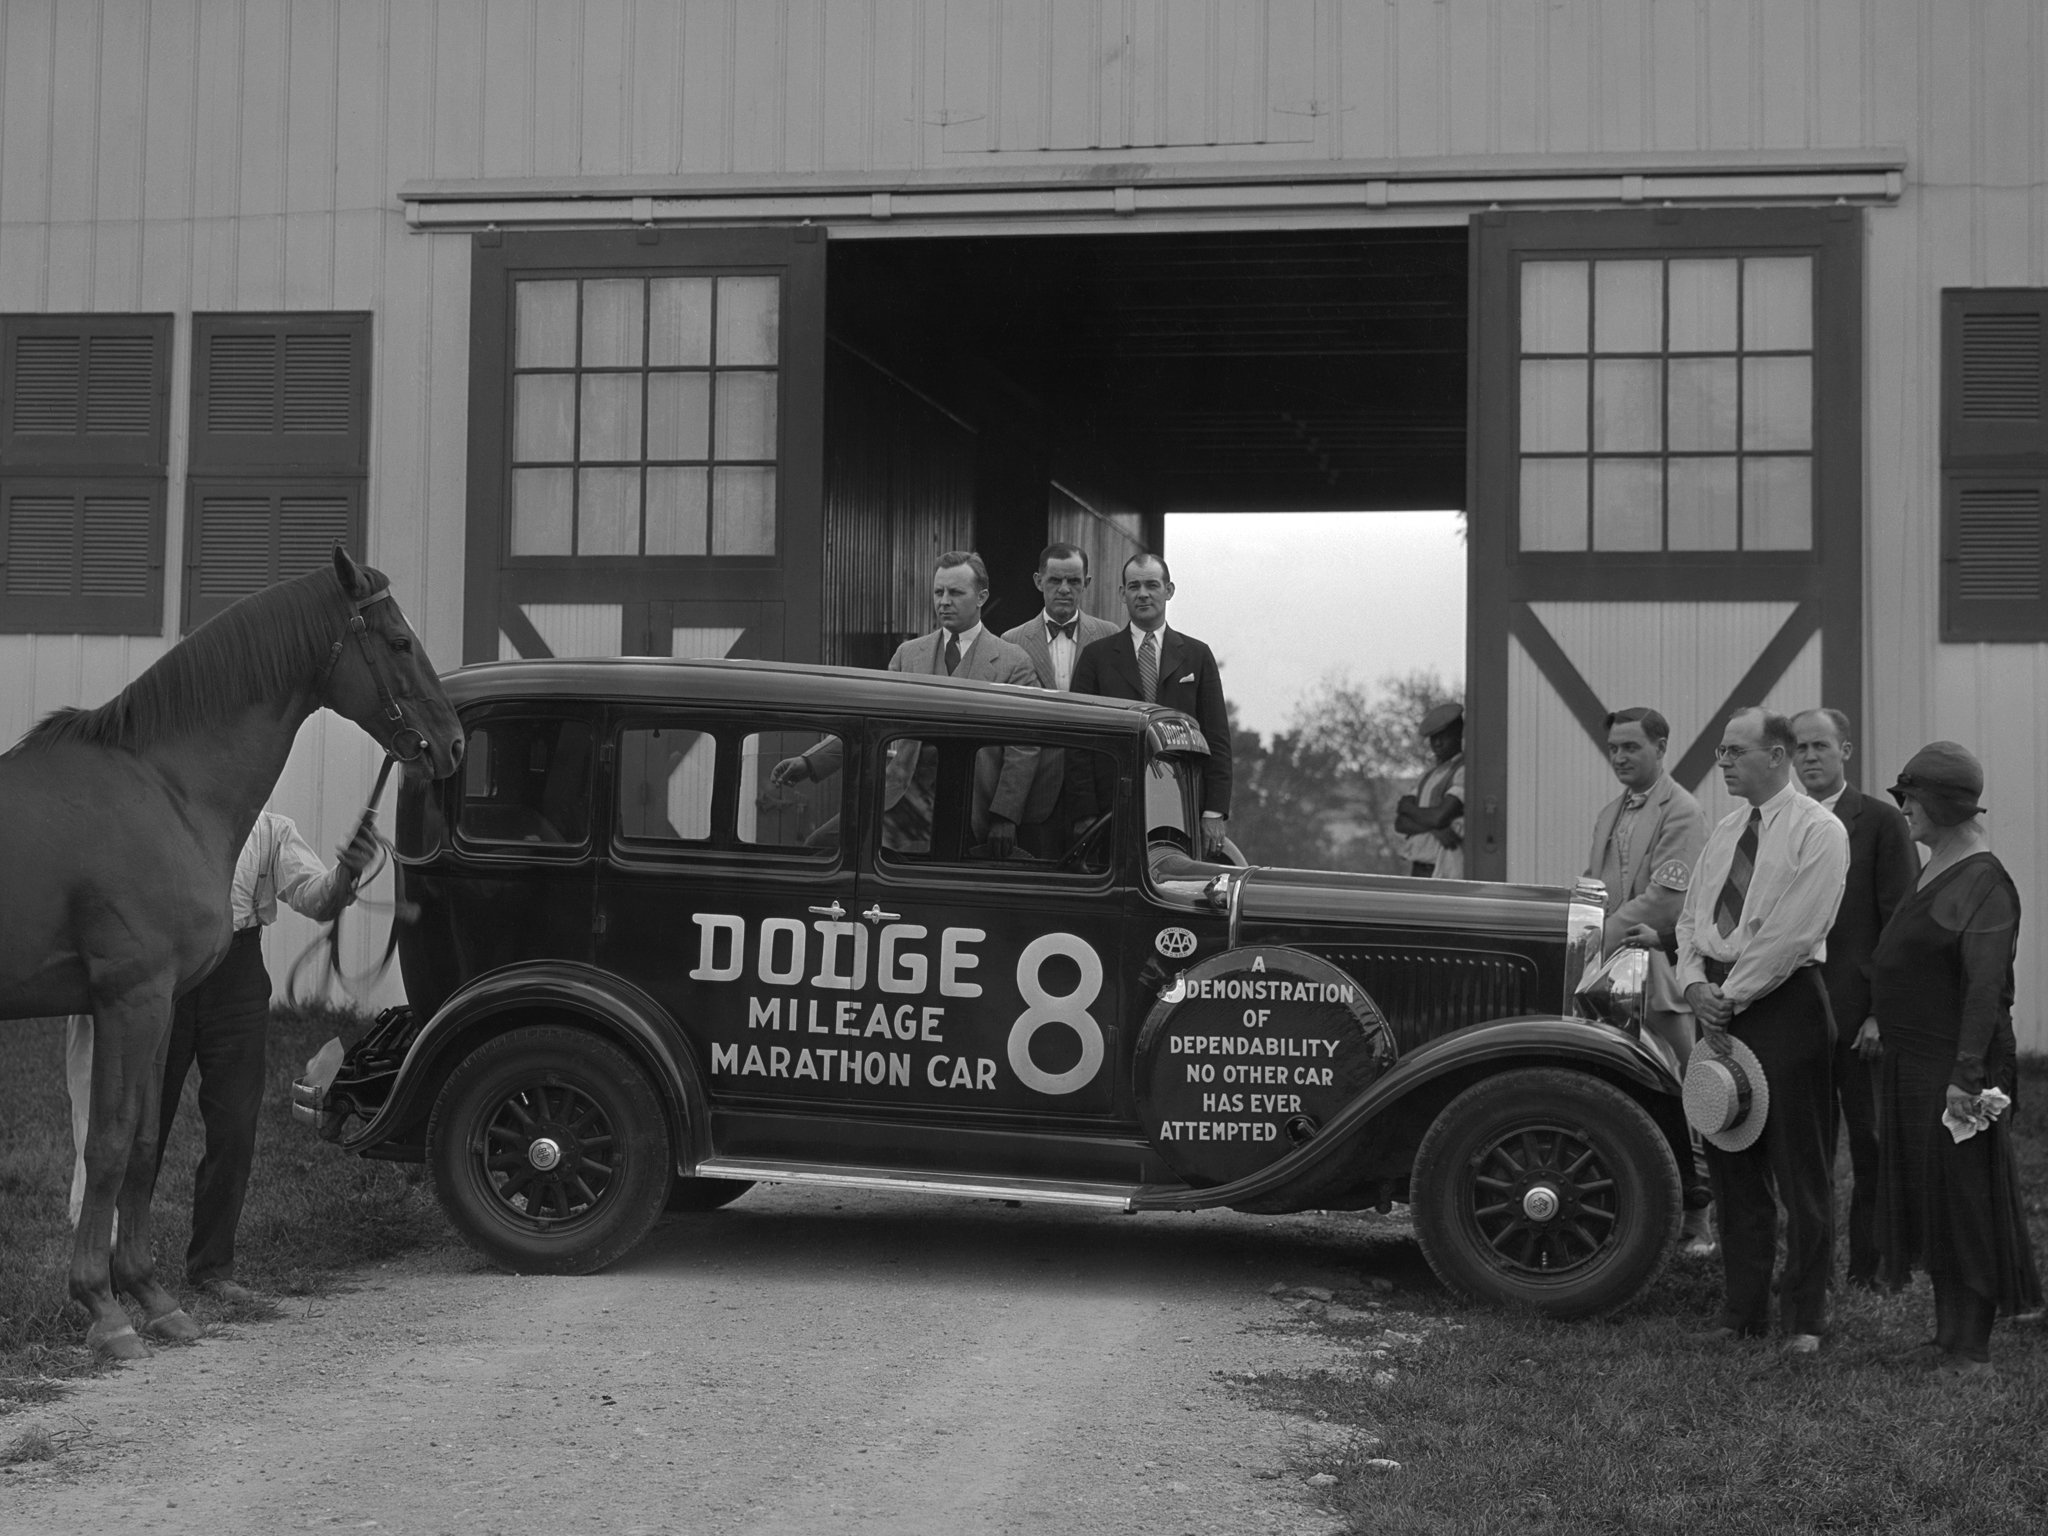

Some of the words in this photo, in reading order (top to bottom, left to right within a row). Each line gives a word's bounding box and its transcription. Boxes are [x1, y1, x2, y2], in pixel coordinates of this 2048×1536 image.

[1160, 931, 1191, 952] AAA
[688, 912, 987, 999] DODGE
[1250, 955, 1266, 973] A
[1186, 980, 1354, 1004] DEMONSTRATION
[748, 996, 945, 1043] MILEAGE
[1006, 932, 1105, 1095] 8
[1242, 1009, 1271, 1028] OF
[1170, 1035, 1341, 1058] DEPENDABILITY
[711, 1042, 911, 1087] MARATHON
[927, 1054, 997, 1090] CAR
[1186, 1063, 1216, 1083] NO
[1223, 1064, 1289, 1085] OTHER
[1293, 1066, 1334, 1086] CAR
[1203, 1092, 1244, 1113] HAS
[1250, 1093, 1301, 1114] EVER
[1159, 1120, 1277, 1142] ATTEMPTED
